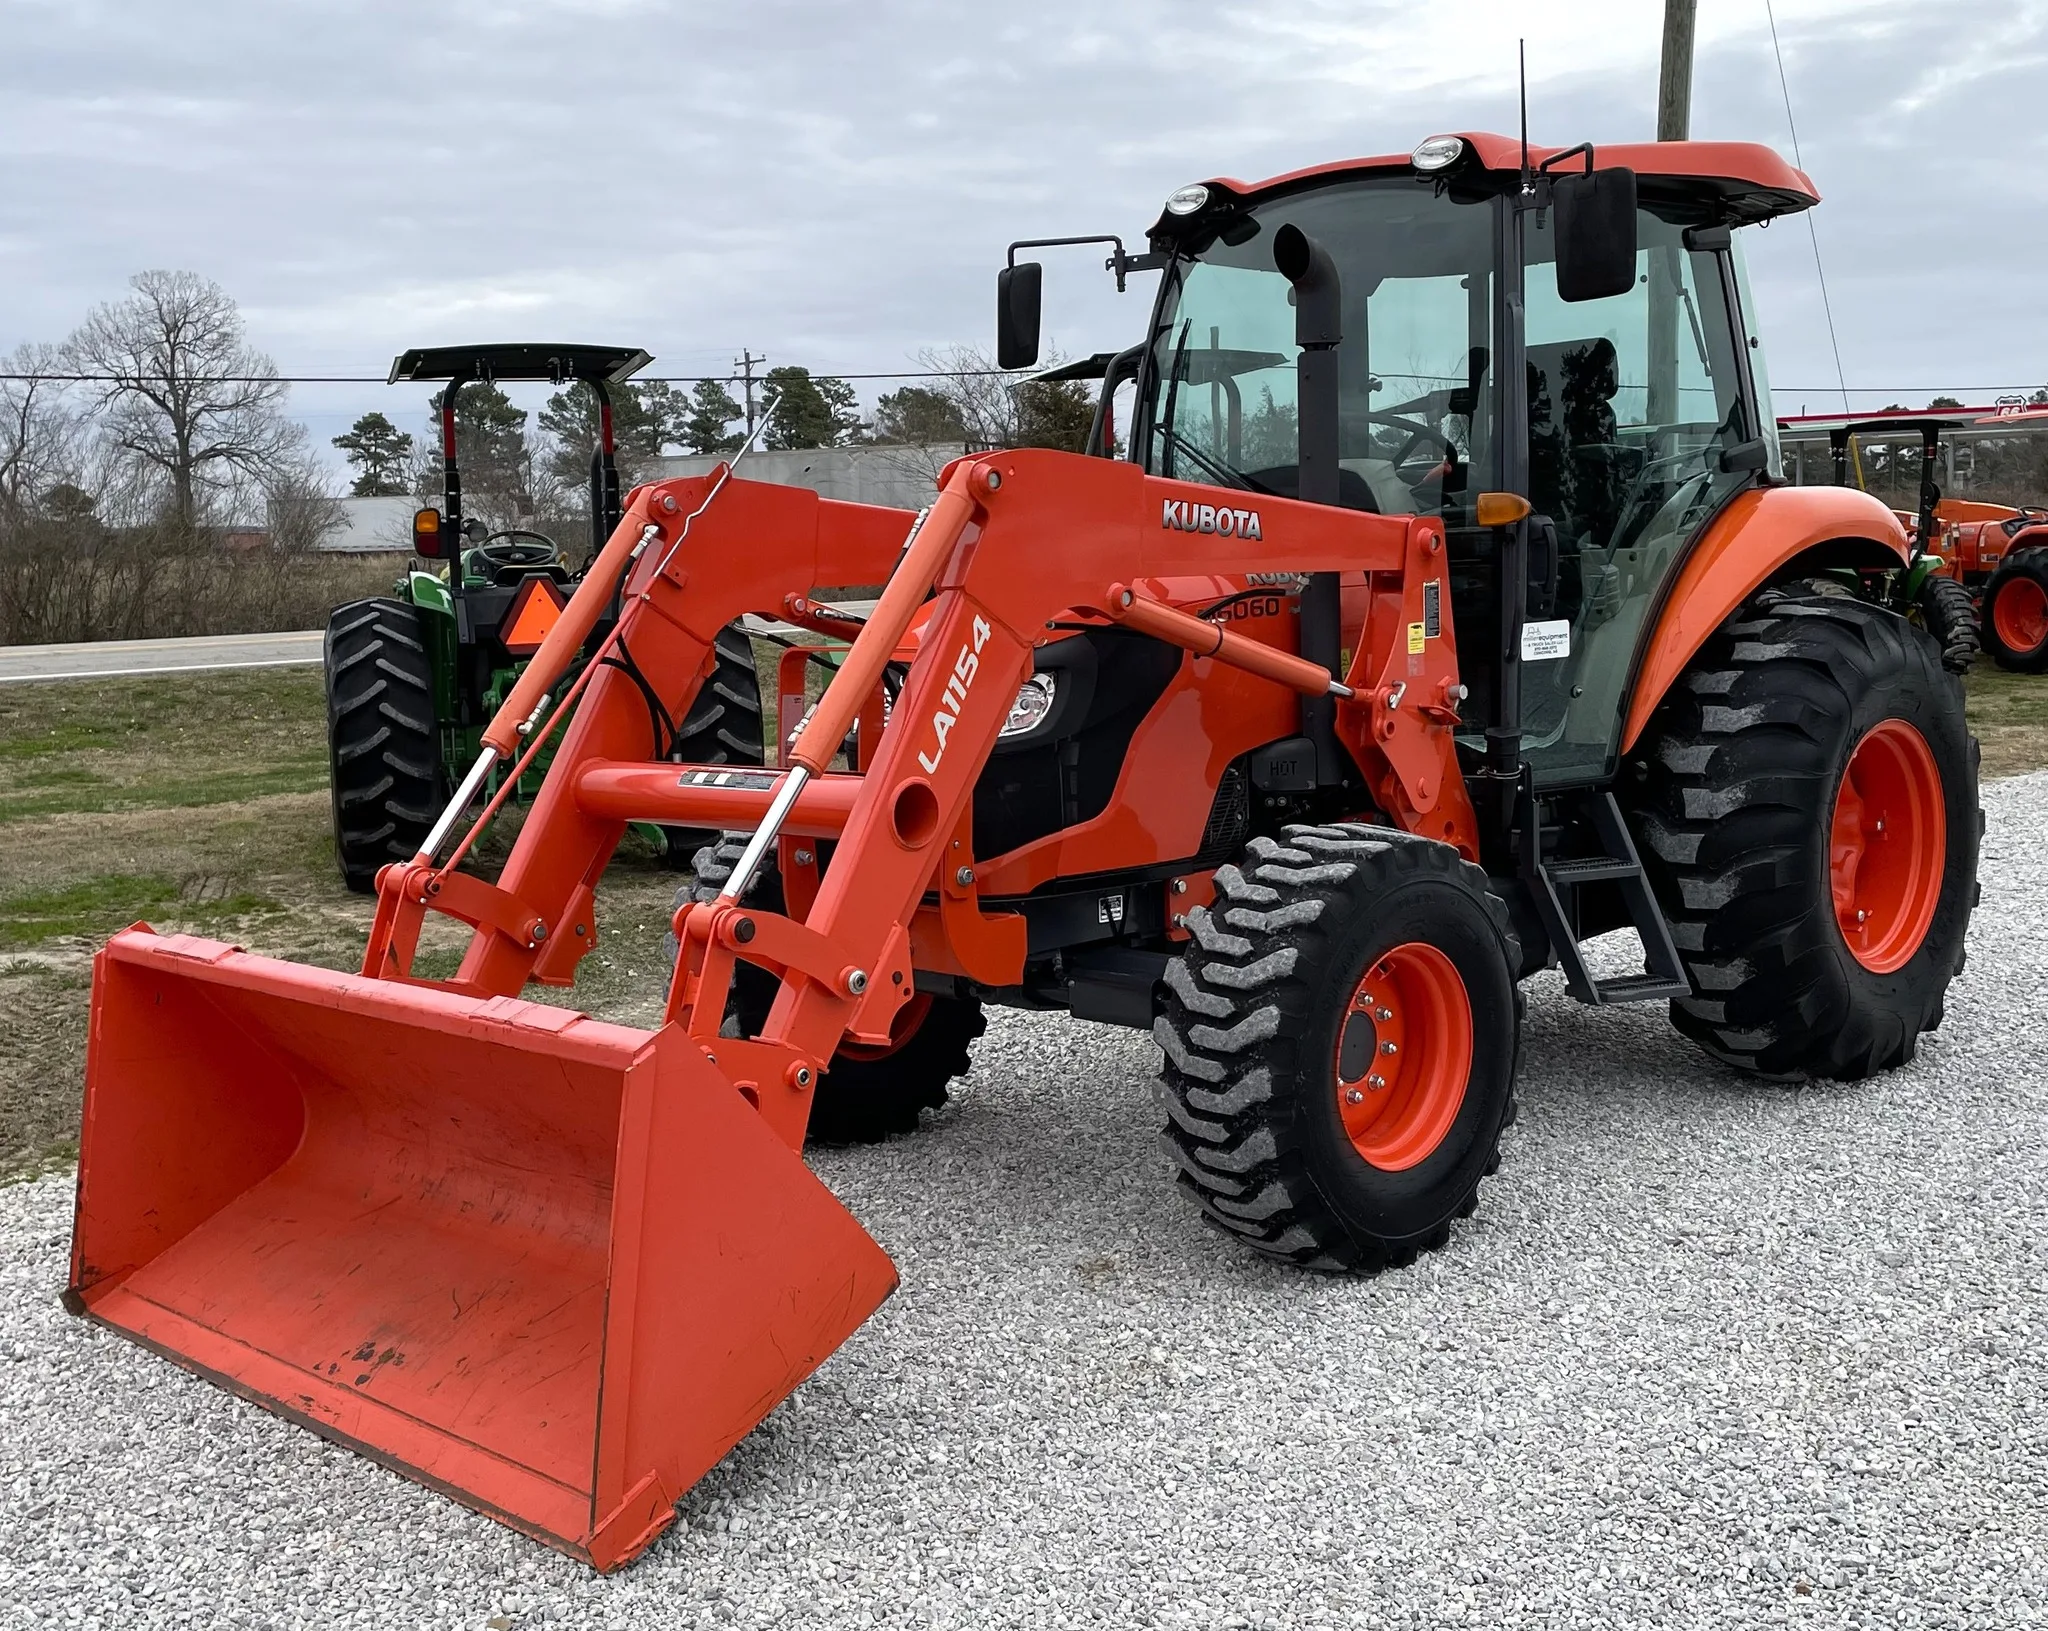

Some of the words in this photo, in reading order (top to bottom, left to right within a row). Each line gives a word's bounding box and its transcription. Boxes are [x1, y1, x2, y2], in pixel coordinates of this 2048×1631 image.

[2000, 407, 2021, 416] 66
[1162, 498, 1263, 540] KUBOTA
[1245, 572, 1299, 586] KUB
[1197, 598, 1280, 620] 060
[917, 614, 992, 775] LA1154
[1270, 760, 1298, 776] HOT
